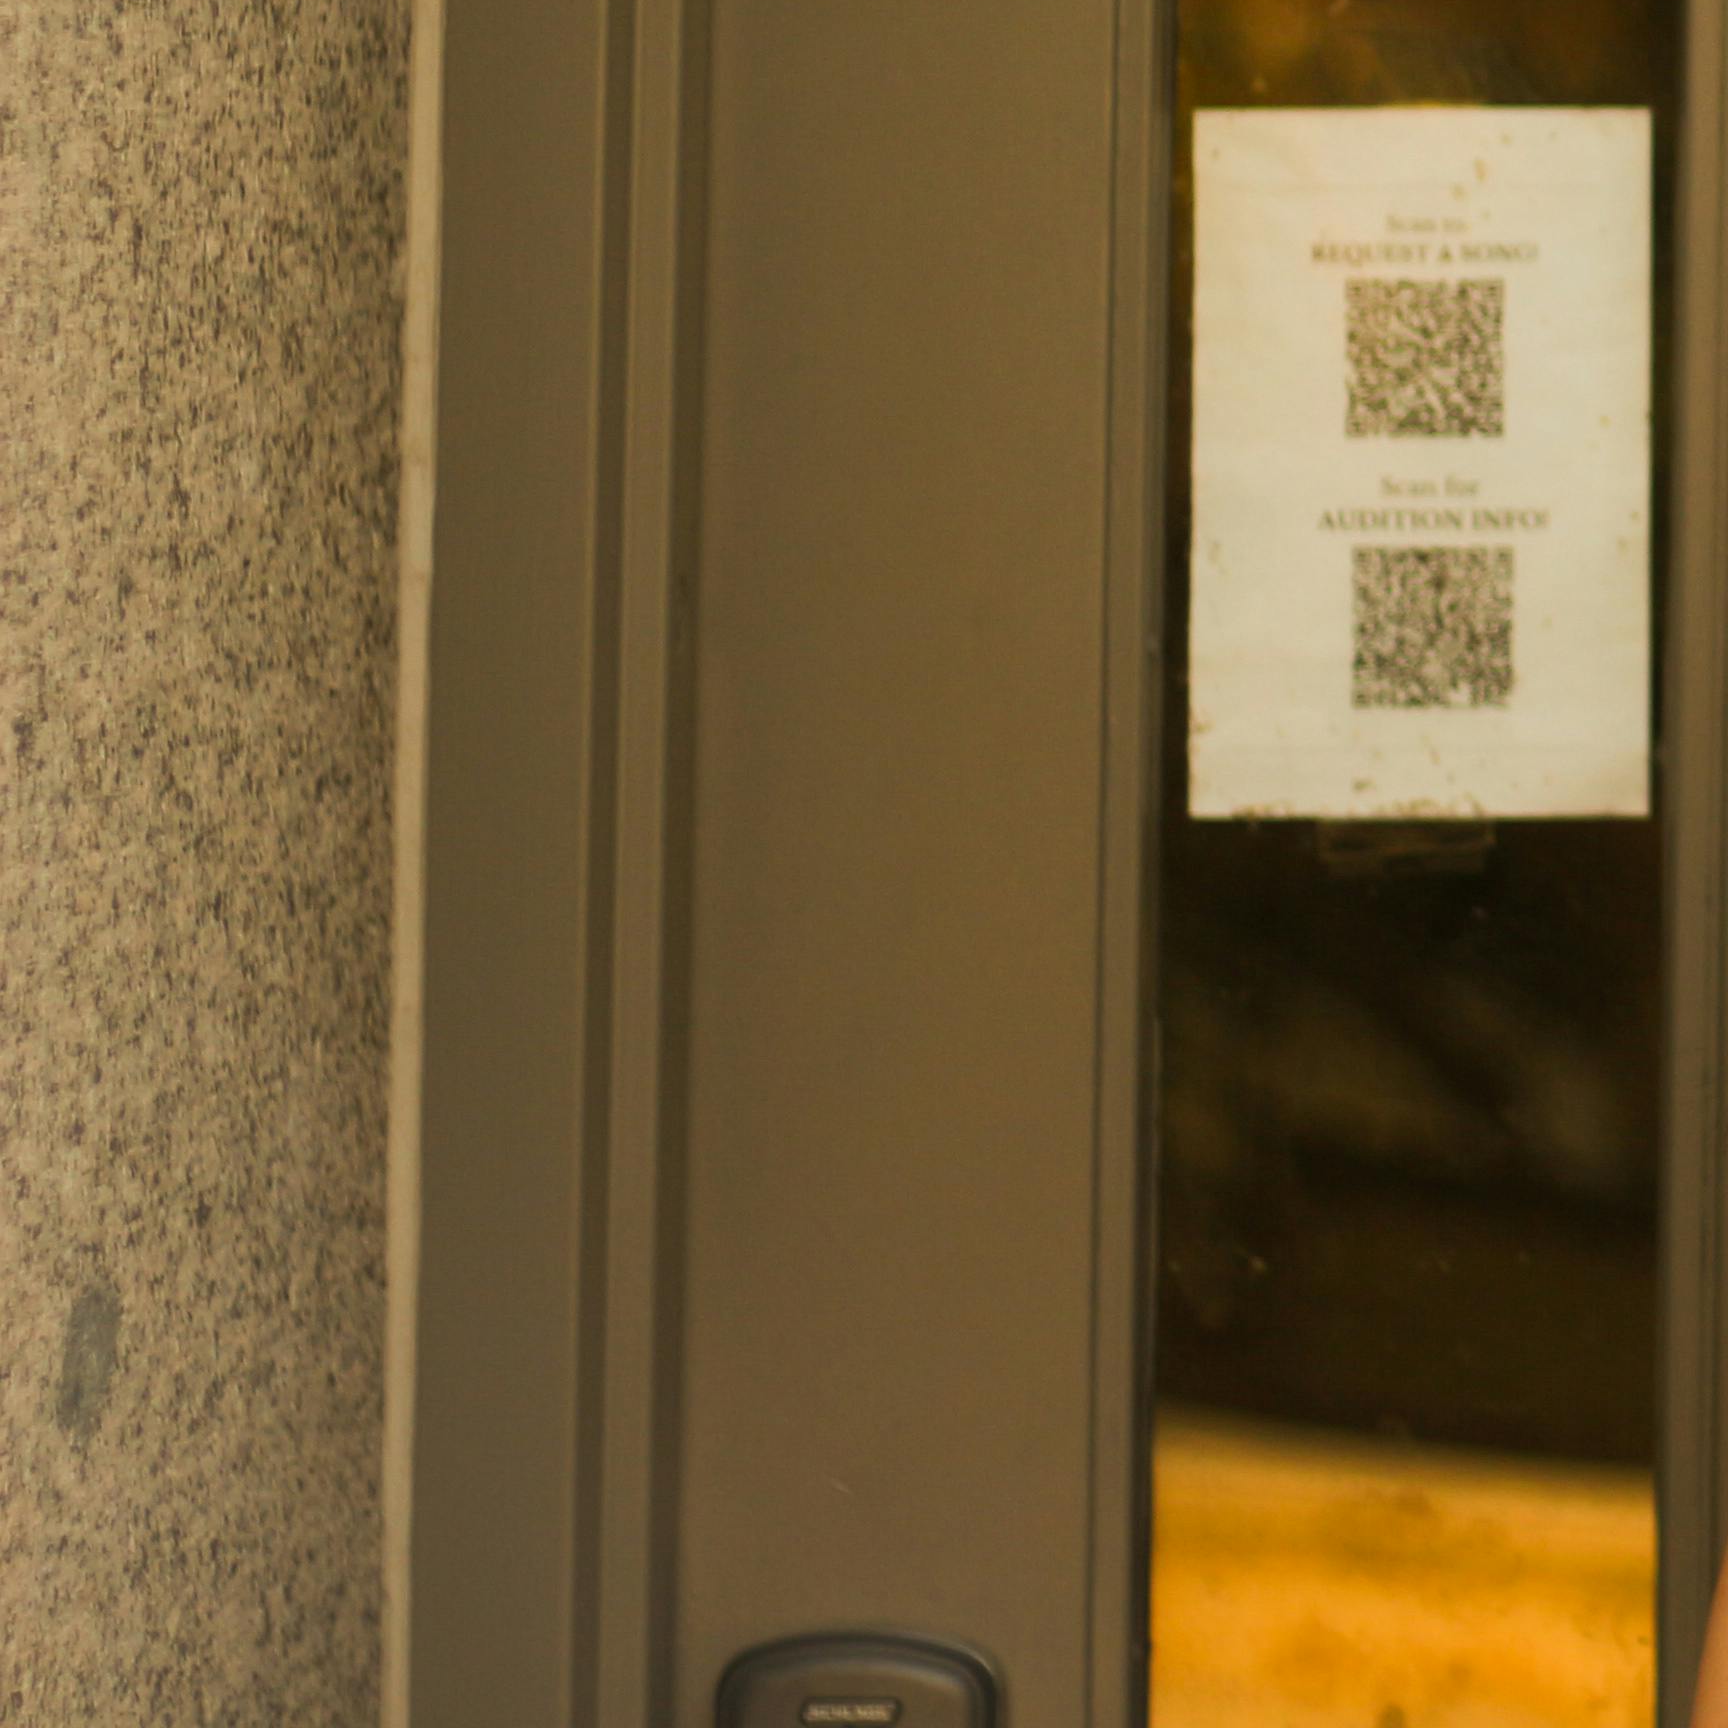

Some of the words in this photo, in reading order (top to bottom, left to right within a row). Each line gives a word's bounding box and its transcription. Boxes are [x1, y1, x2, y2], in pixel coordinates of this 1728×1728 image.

[1311, 242, 1429, 266] REQUEST
[1437, 243, 1454, 264] A
[1380, 475, 1437, 497] Scan
[1444, 473, 1480, 497] for
[1317, 507, 1464, 530] AUDITION
